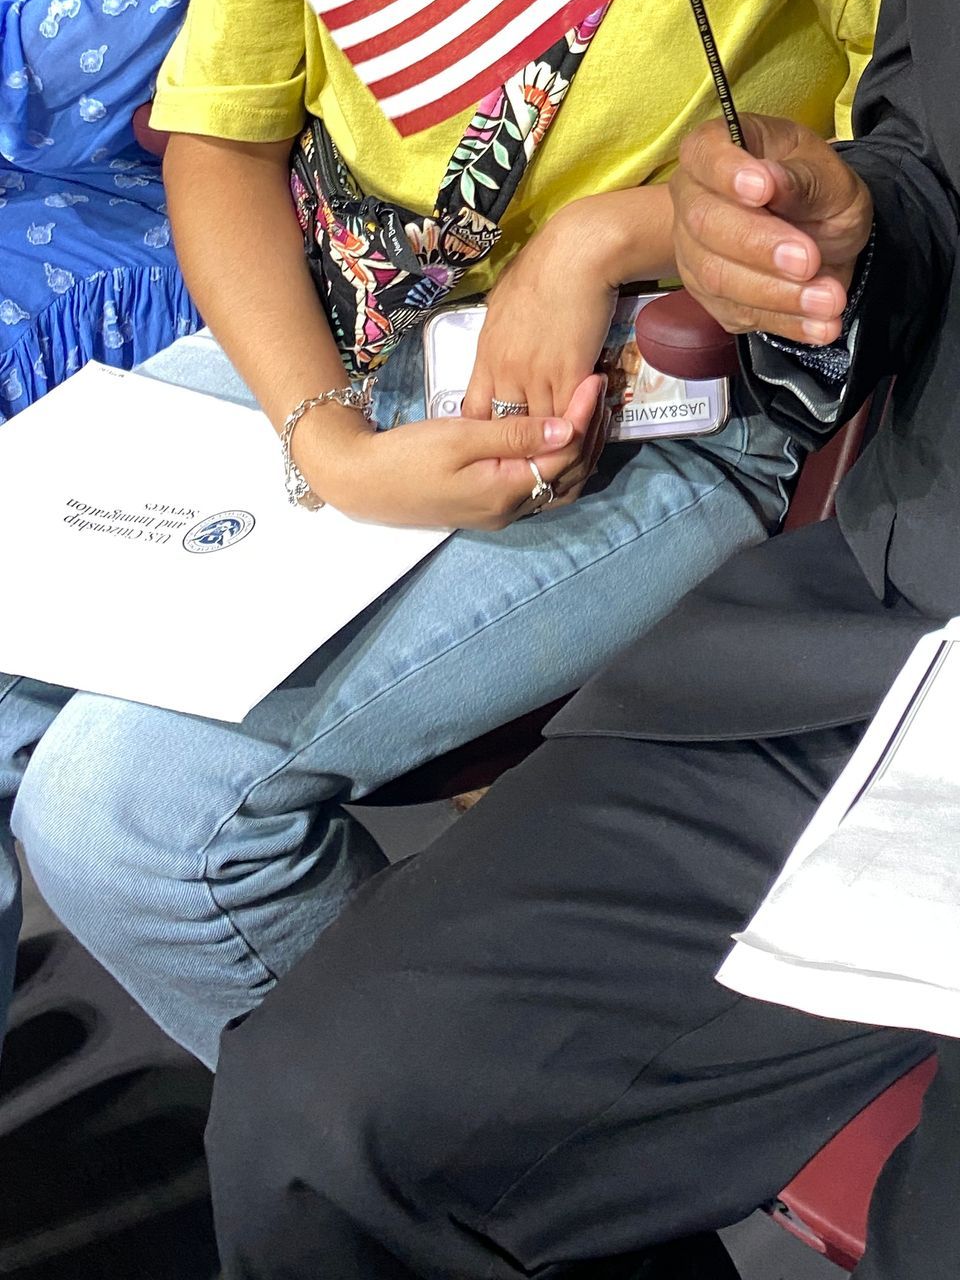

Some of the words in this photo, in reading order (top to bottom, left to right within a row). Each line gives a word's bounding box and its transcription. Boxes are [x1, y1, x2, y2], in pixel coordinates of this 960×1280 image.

[704, 34, 728, 99] Immigration
[722, 101, 735, 121] and
[615, 402, 706, 423] JAS&XAVIER
[66, 498, 155, 527] Immigration
[144, 503, 200, 519] Services
[63, 513, 143, 539] Citizenship
[155, 519, 187, 530] and
